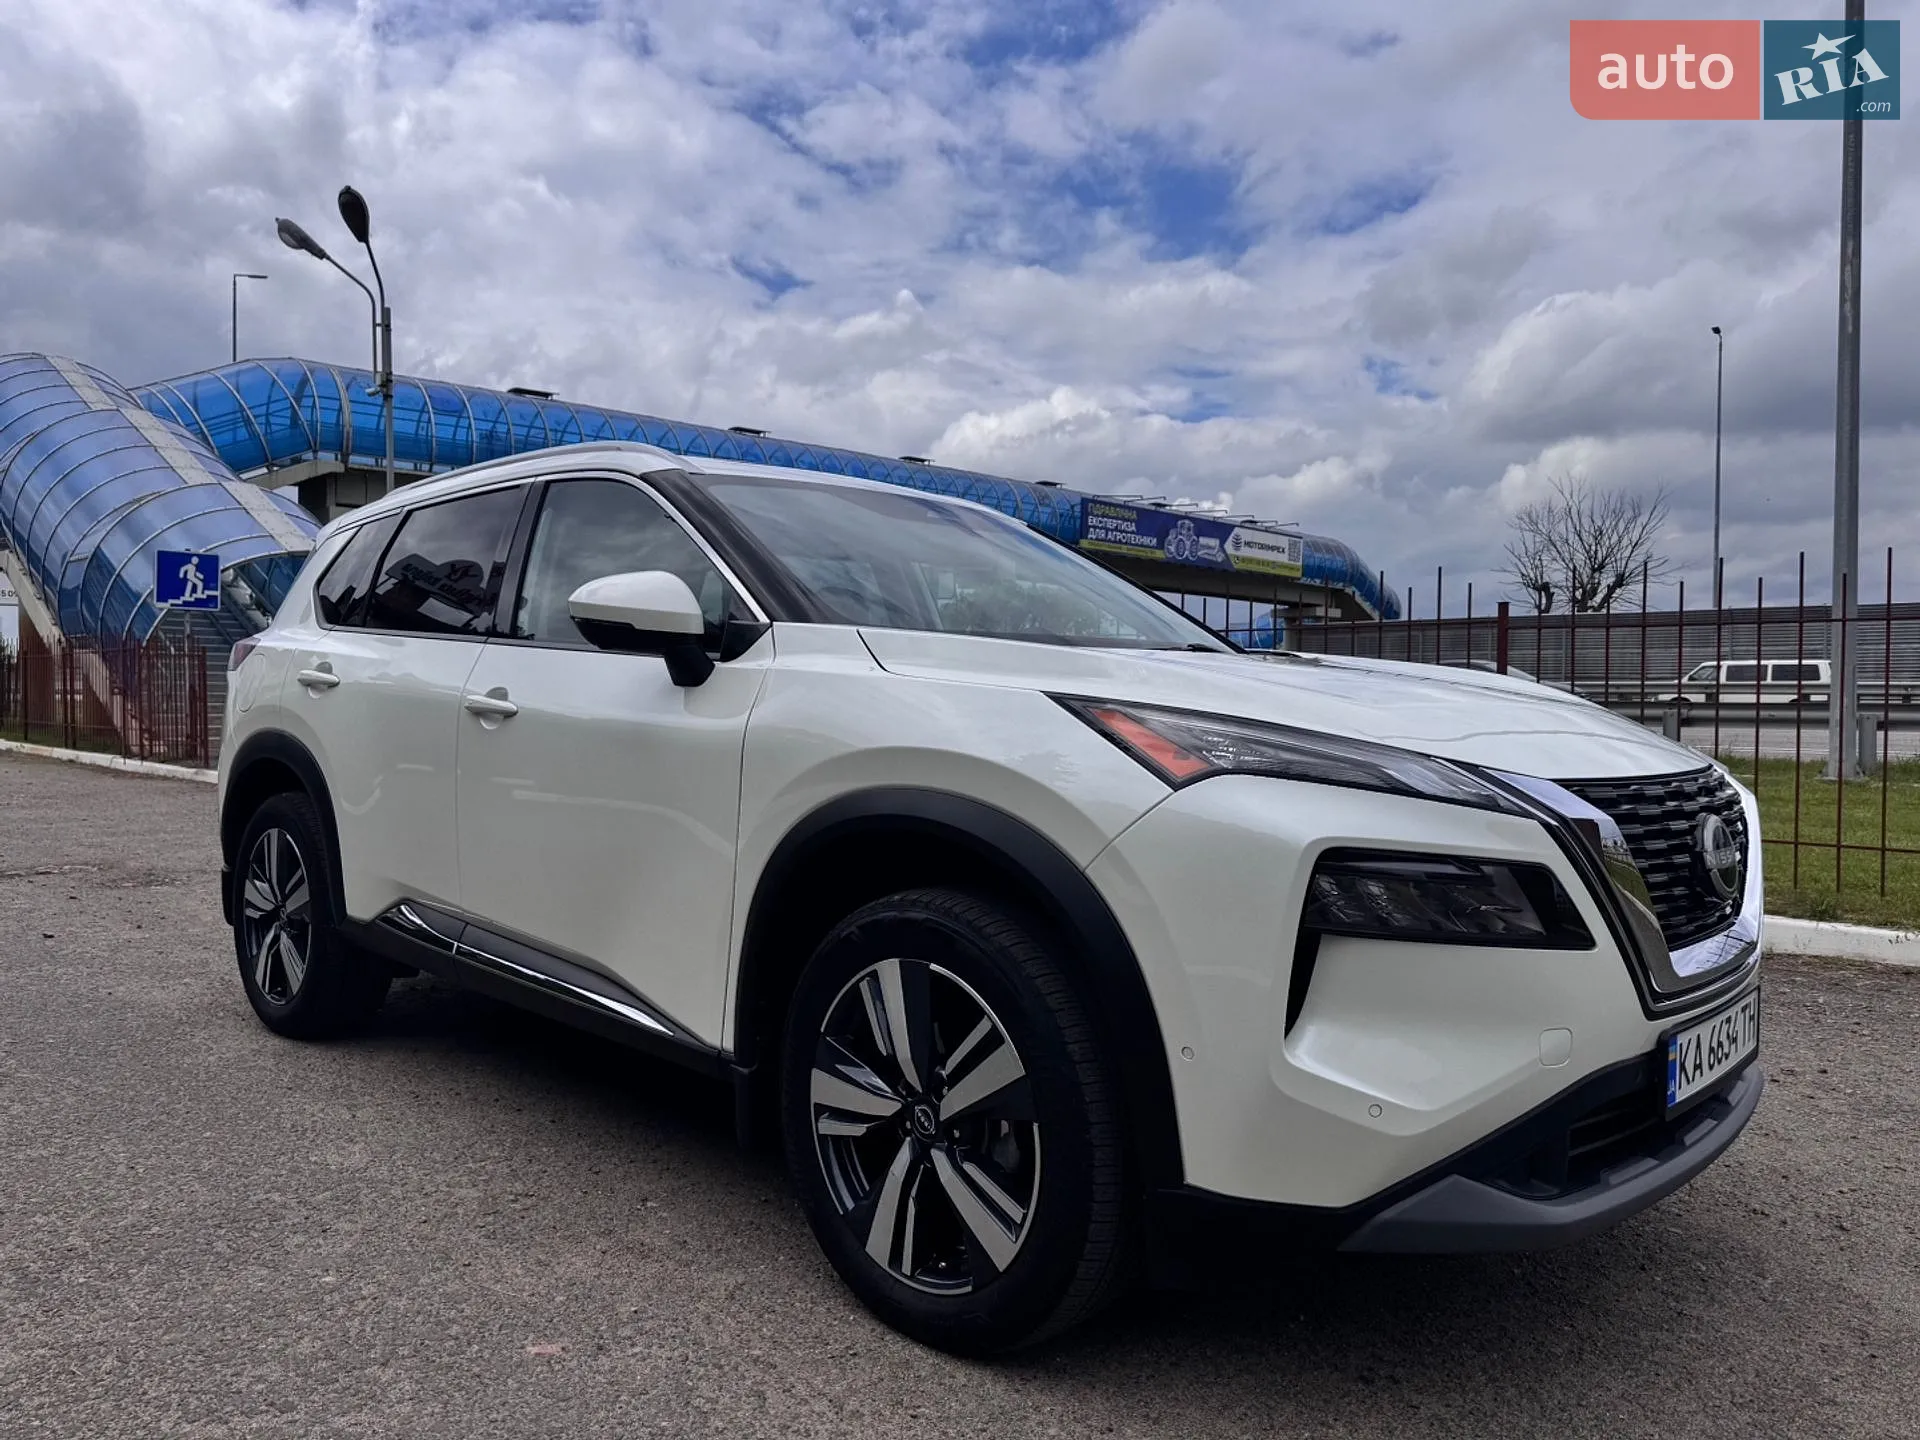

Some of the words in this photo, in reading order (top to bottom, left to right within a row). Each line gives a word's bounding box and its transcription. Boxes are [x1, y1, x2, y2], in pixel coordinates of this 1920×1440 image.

[1088, 516, 1137, 533] ЕКСПЕРТИЗА
[1088, 528, 1106, 540] ДЛЯ
[1107, 531, 1158, 547] АГРОТЕХНІКИ
[1678, 1032, 1704, 1090] KA
[1707, 1011, 1739, 1072] 6634
[1740, 997, 1756, 1049] TH
